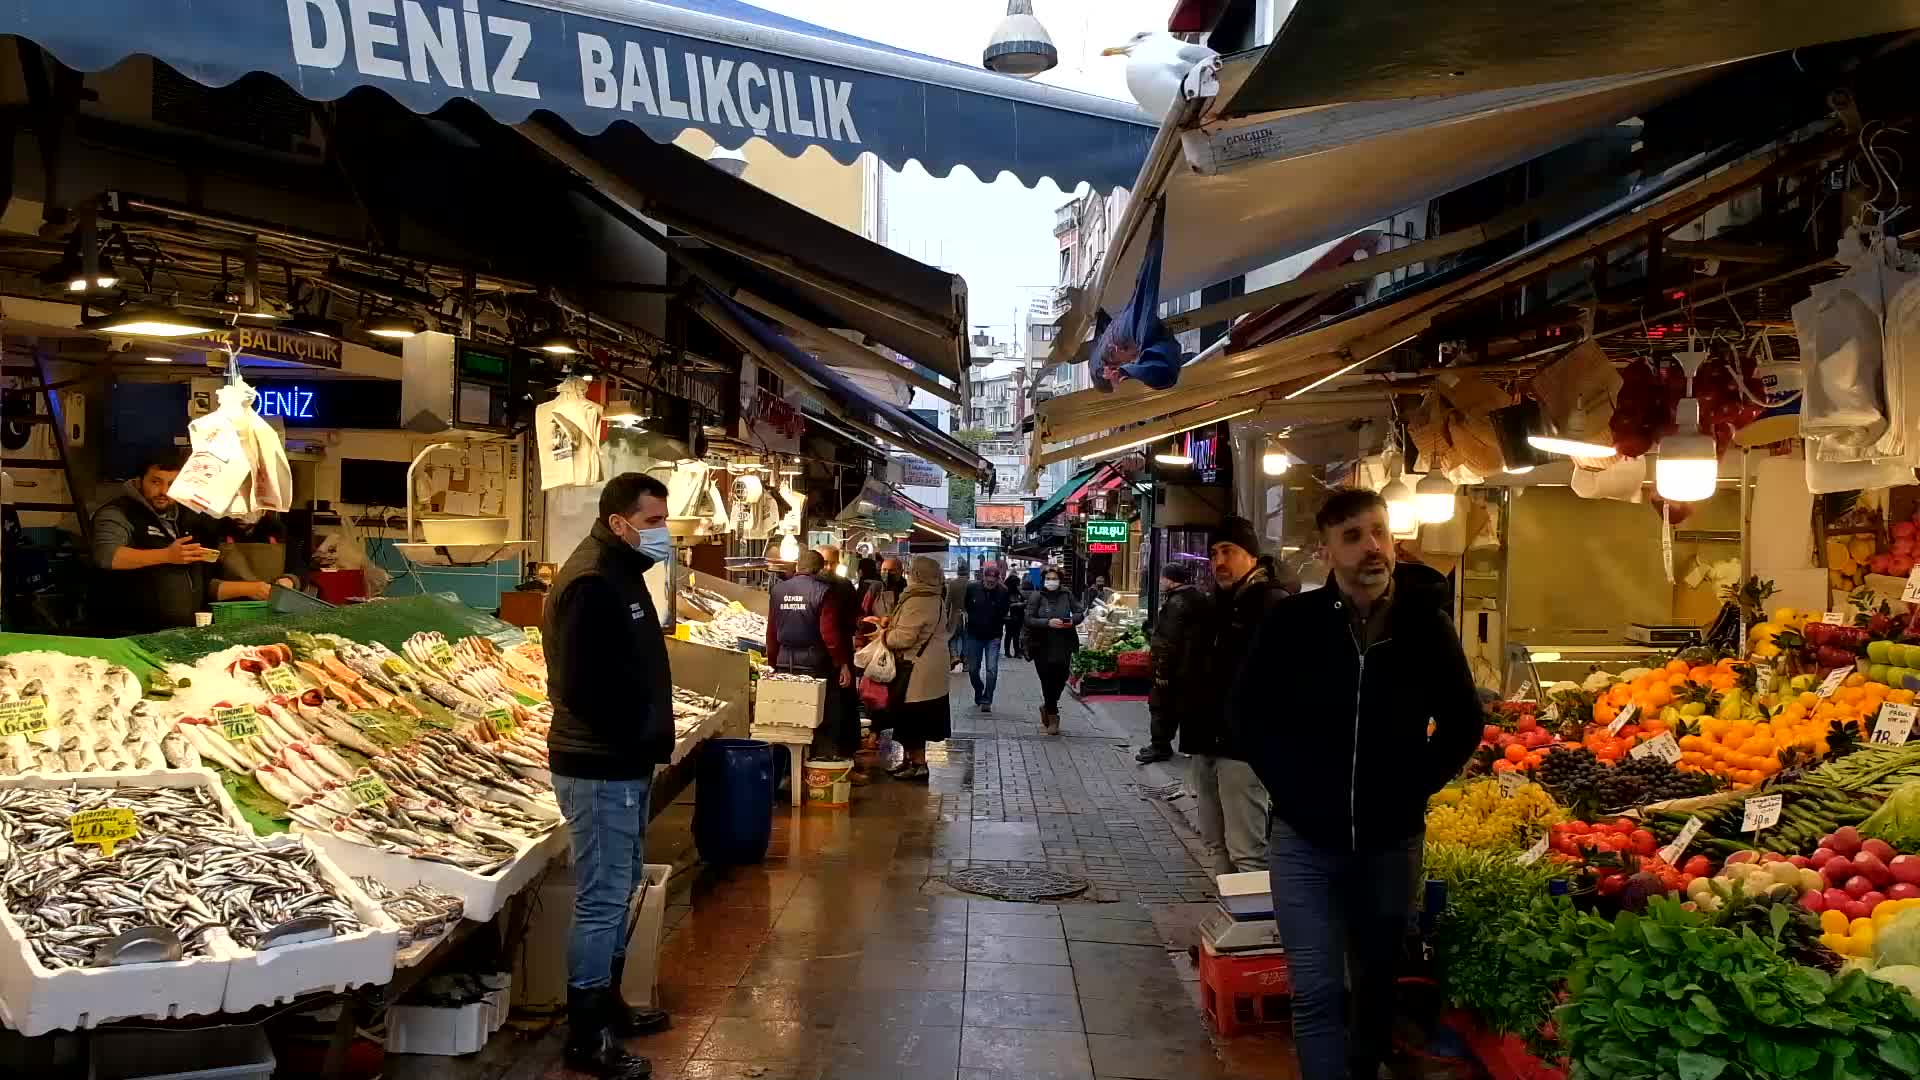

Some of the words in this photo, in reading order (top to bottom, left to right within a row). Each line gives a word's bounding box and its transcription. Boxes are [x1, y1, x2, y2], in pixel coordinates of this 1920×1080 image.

[287, 0, 541, 100] DENİZ
[577, 31, 862, 144] BALIKÇILIK
[239, 328, 338, 362] BALIKÇILIK
